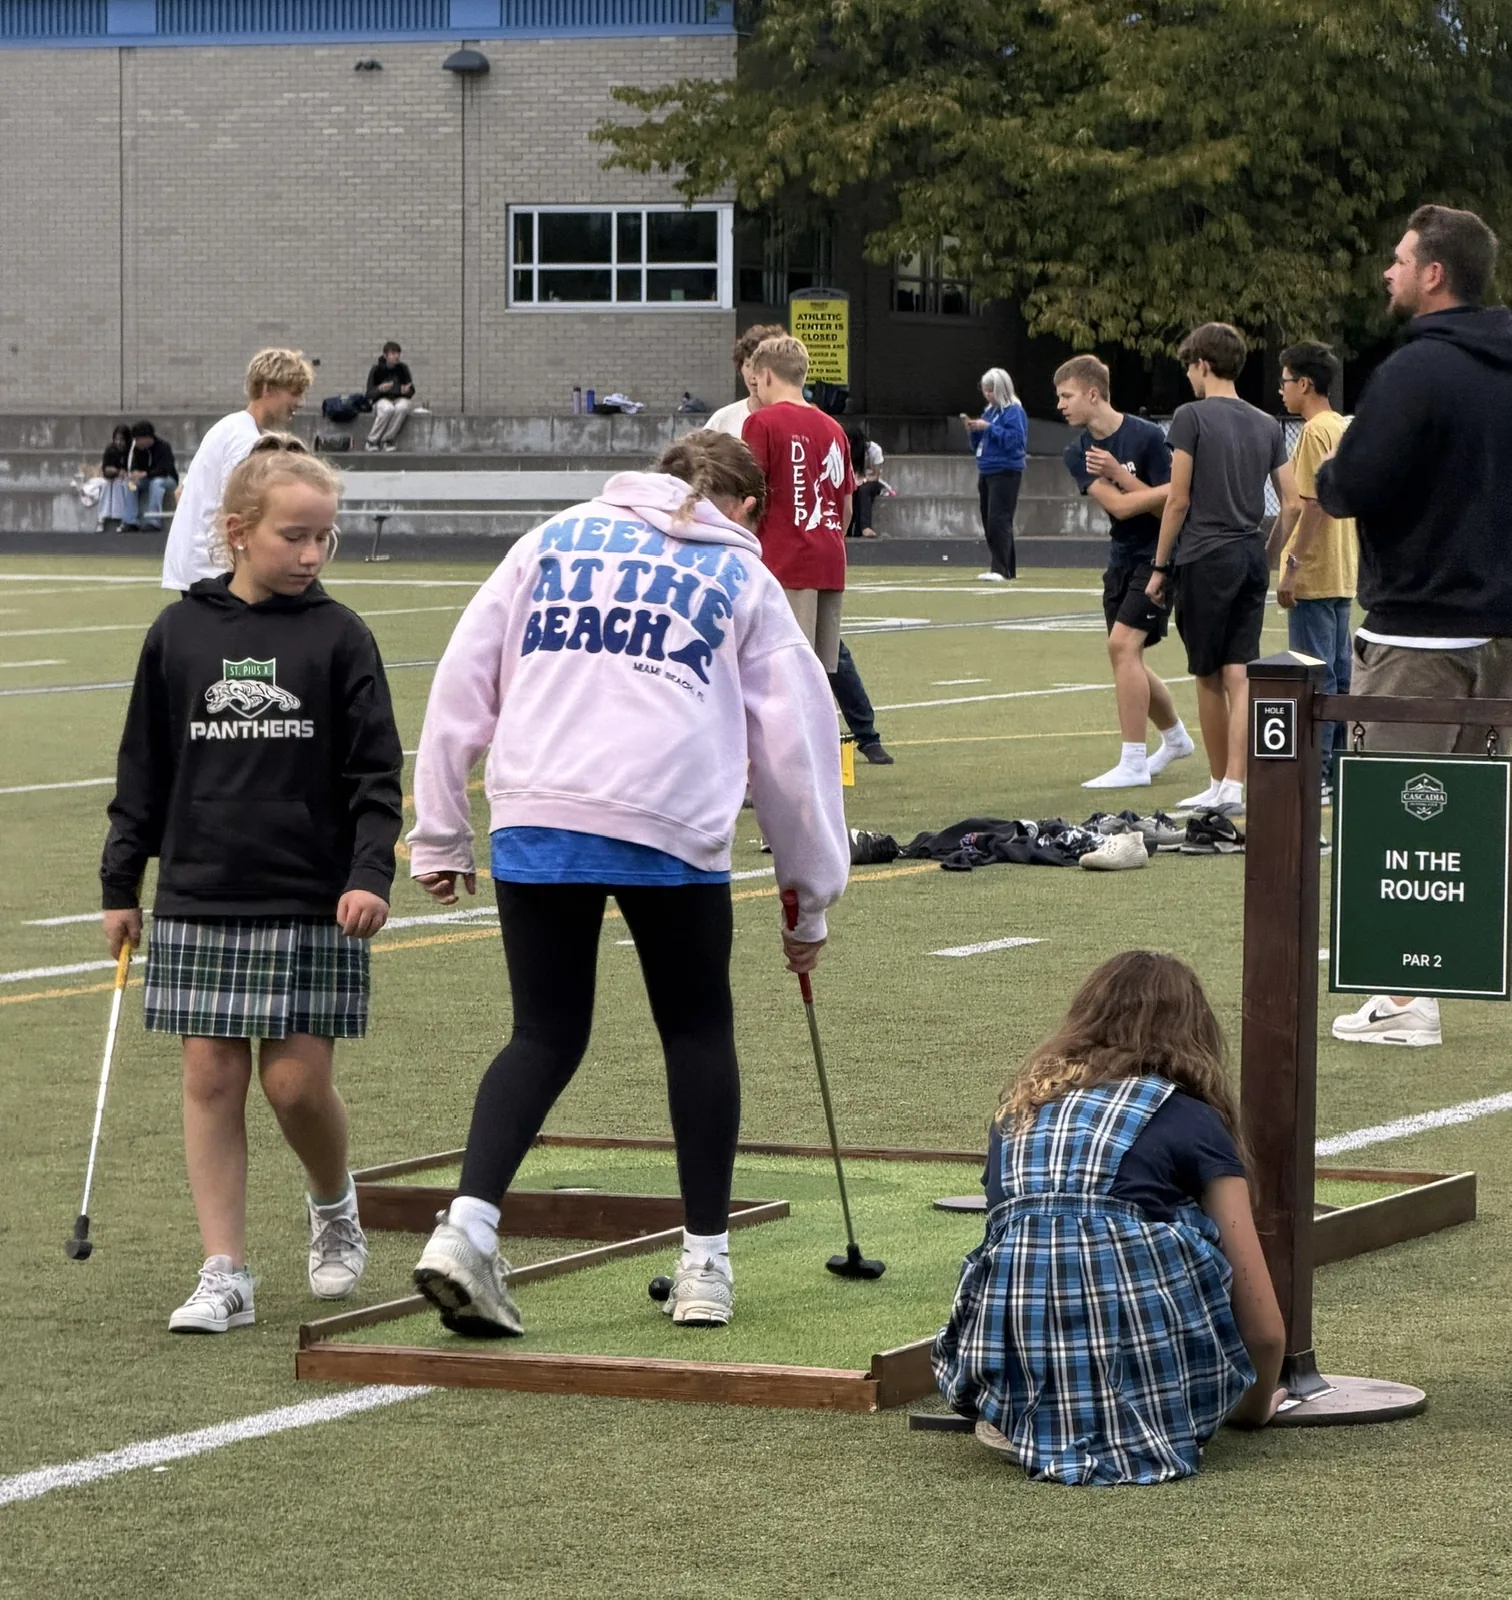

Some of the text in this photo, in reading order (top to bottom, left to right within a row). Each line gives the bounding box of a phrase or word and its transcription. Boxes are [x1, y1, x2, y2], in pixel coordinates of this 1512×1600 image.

[795, 323, 844, 331] CENTER IS
[797, 313, 842, 321] ATHLETIC
[801, 333, 838, 341] CLOSED
[791, 441, 808, 526] DEEP
[538, 517, 666, 556] MEET
[532, 558, 733, 650] AT THE
[521, 606, 671, 661] BEACH
[230, 666, 241, 676] ST.
[243, 665, 261, 676] PIUS
[1264, 707, 1285, 715] HOLE
[190, 720, 314, 740] PANTHERS
[1264, 718, 1286, 750] 6
[1403, 793, 1445, 801] CASCADIA
[1385, 850, 1461, 872] IN THE
[1380, 879, 1464, 902] ROUGH
[1402, 953, 1442, 967] PAR 2
